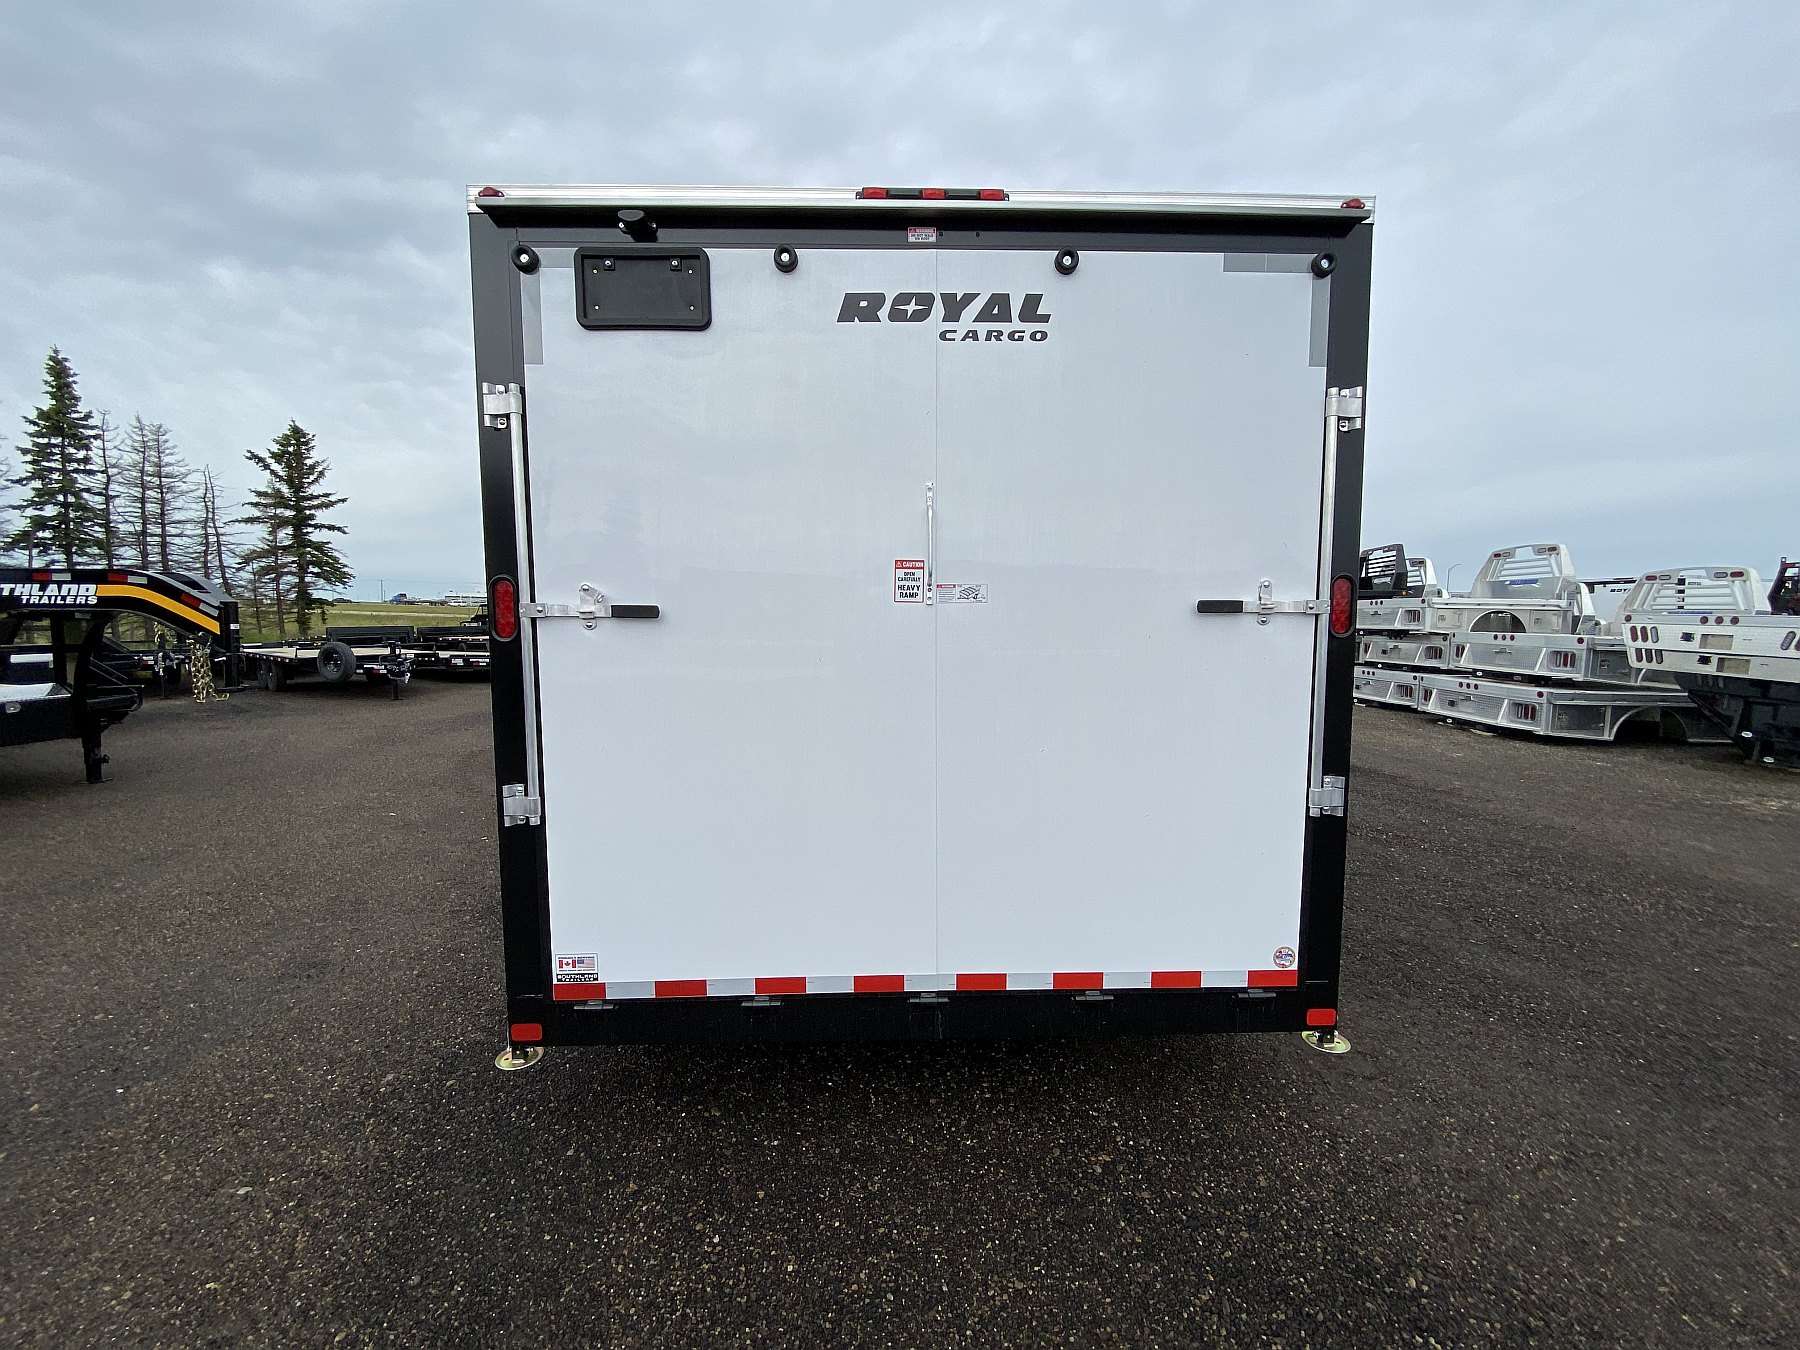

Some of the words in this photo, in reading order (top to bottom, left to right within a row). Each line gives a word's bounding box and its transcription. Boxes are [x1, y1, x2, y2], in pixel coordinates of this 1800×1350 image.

[836, 292, 1052, 323] ROYAL
[939, 329, 1049, 342] CARGO
[897, 584, 921, 592] HEAVY
[899, 591, 919, 599] RAMP
[20, 596, 98, 605] TRAILERS
